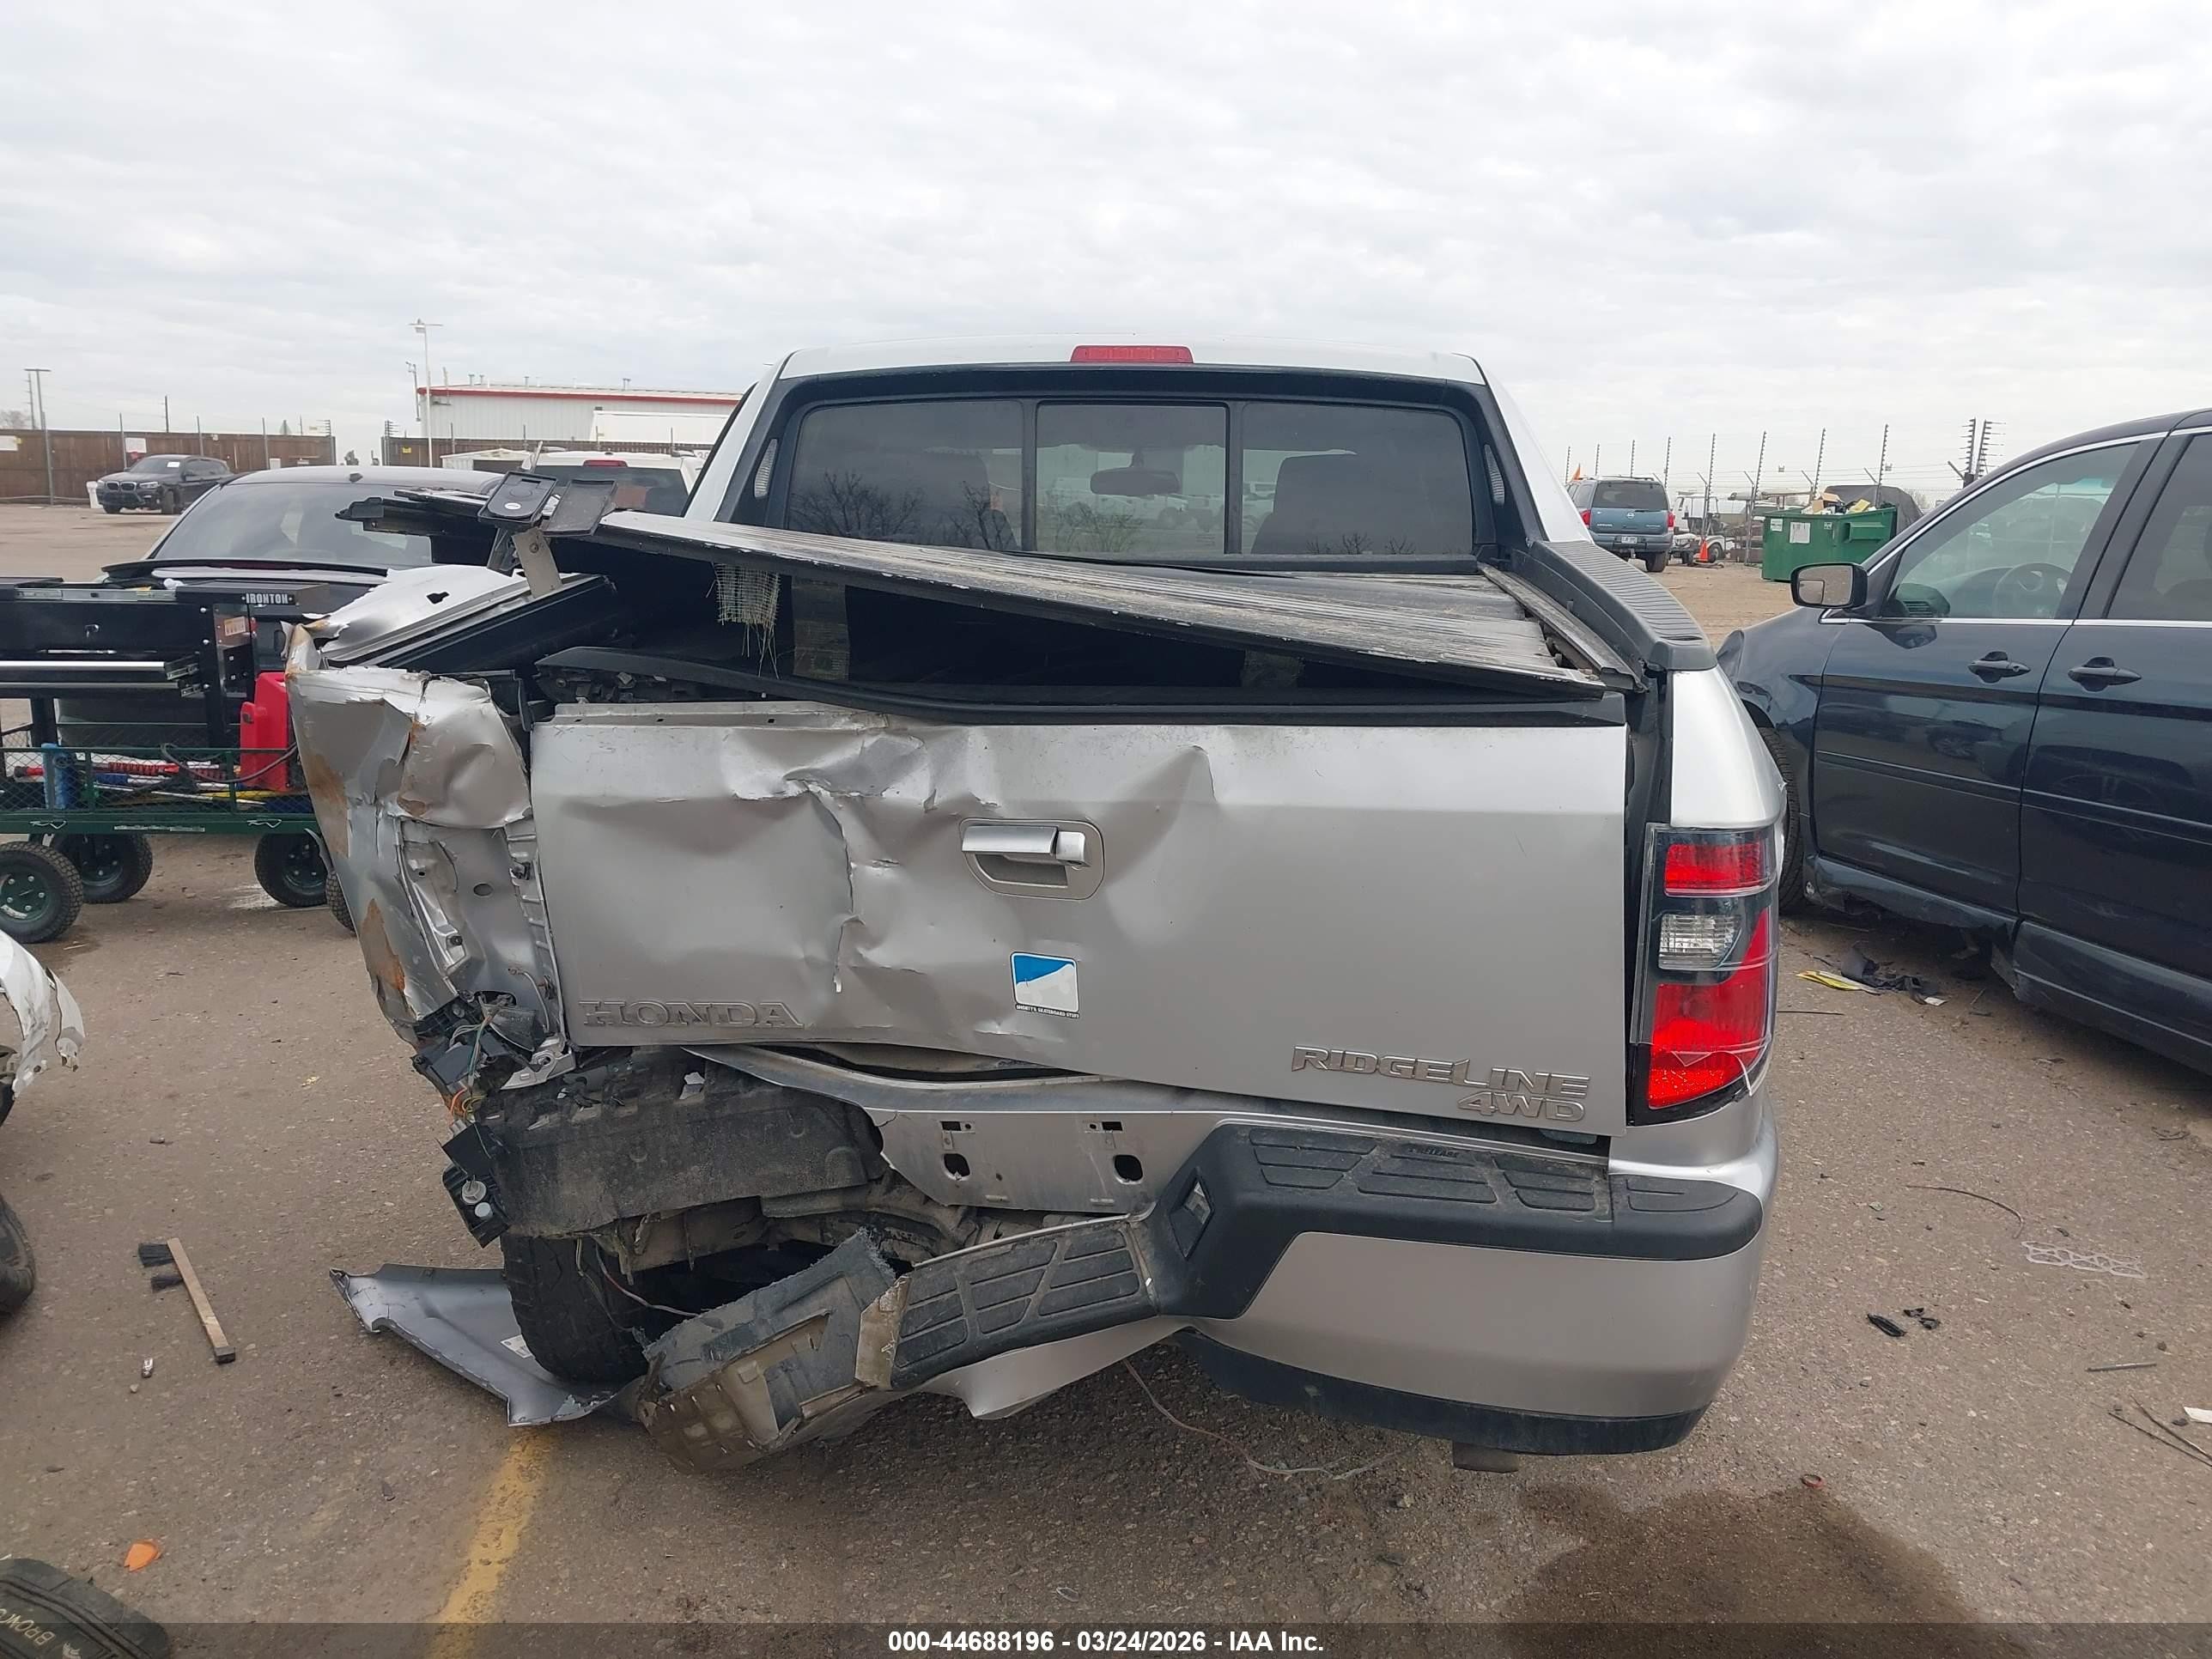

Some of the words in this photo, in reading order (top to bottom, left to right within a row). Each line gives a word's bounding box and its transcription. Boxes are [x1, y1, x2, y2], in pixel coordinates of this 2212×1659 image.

[579, 1000, 805, 1029] HONDA
[1037, 1007, 1066, 1017] SKATEBOARD
[1291, 1046, 1590, 1098] RIDGELINE
[1457, 1091, 1585, 1123] 4WD
